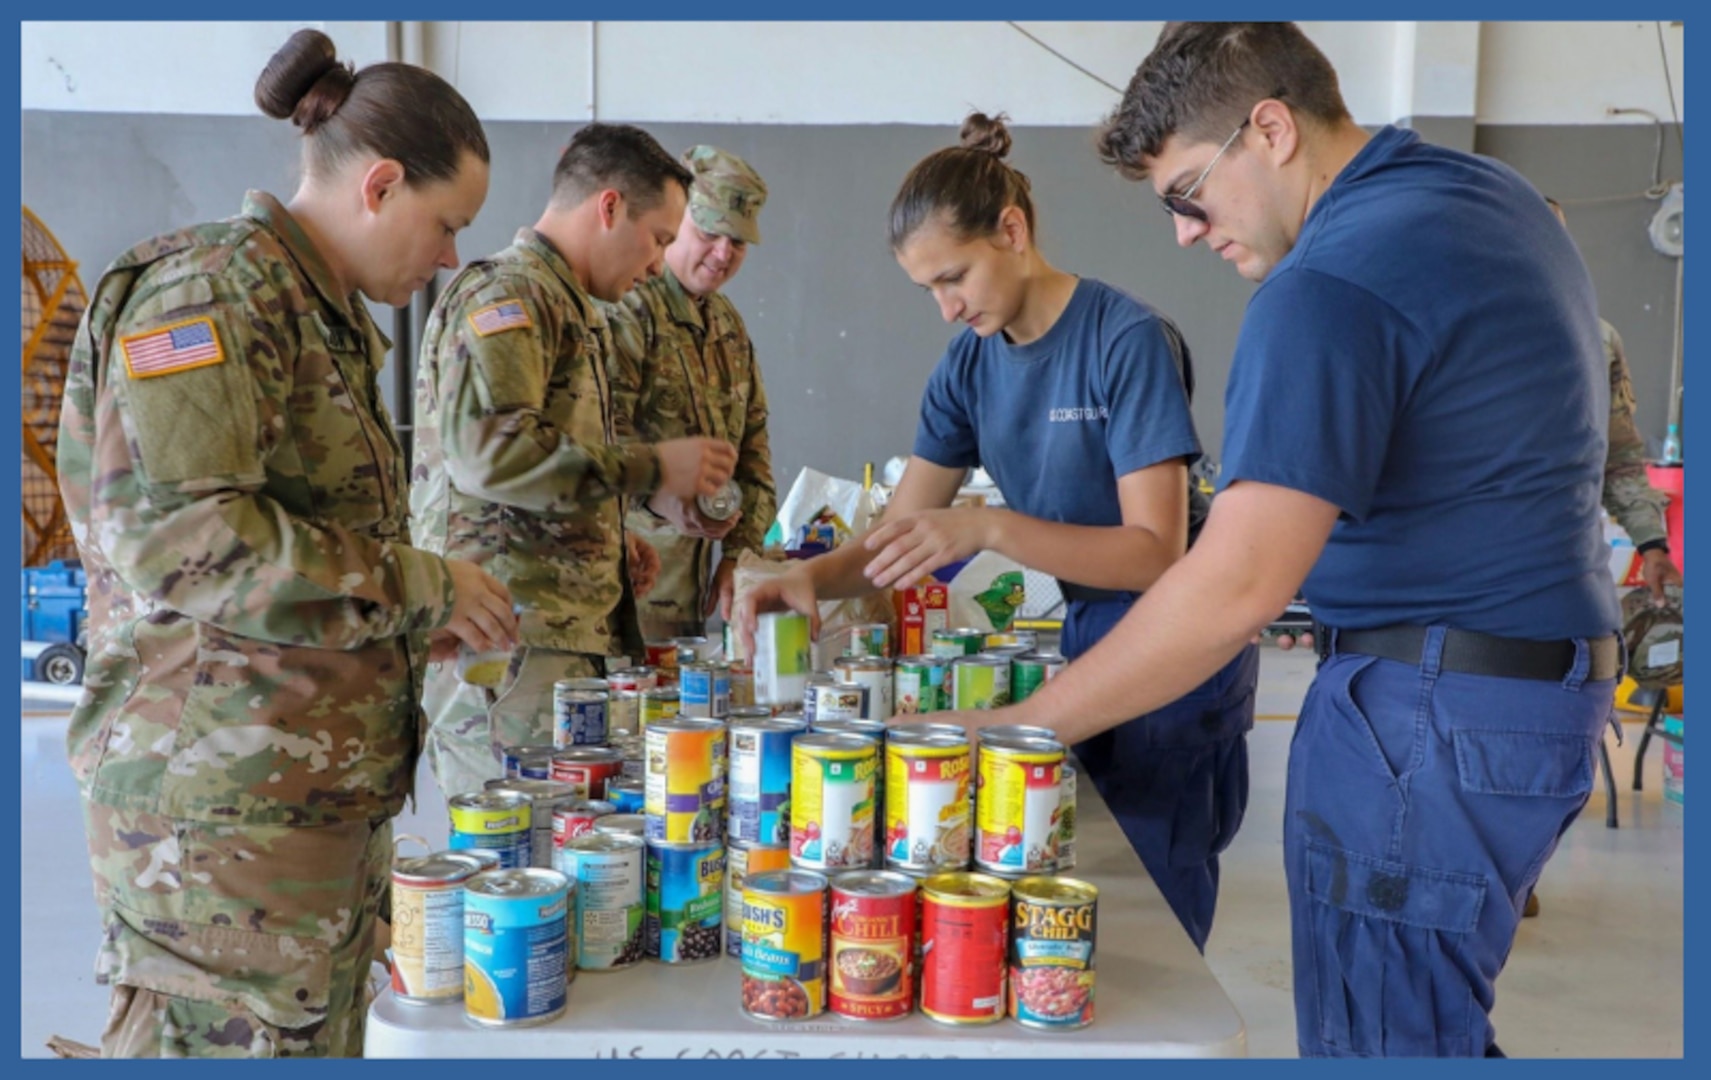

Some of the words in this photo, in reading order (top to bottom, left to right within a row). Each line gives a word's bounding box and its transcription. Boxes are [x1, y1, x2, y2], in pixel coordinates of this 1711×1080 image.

[742, 902, 783, 929] USH'S
[837, 912, 899, 937] CHILI
[1015, 902, 1094, 931] STAGG
[1029, 923, 1079, 939] CHILI
